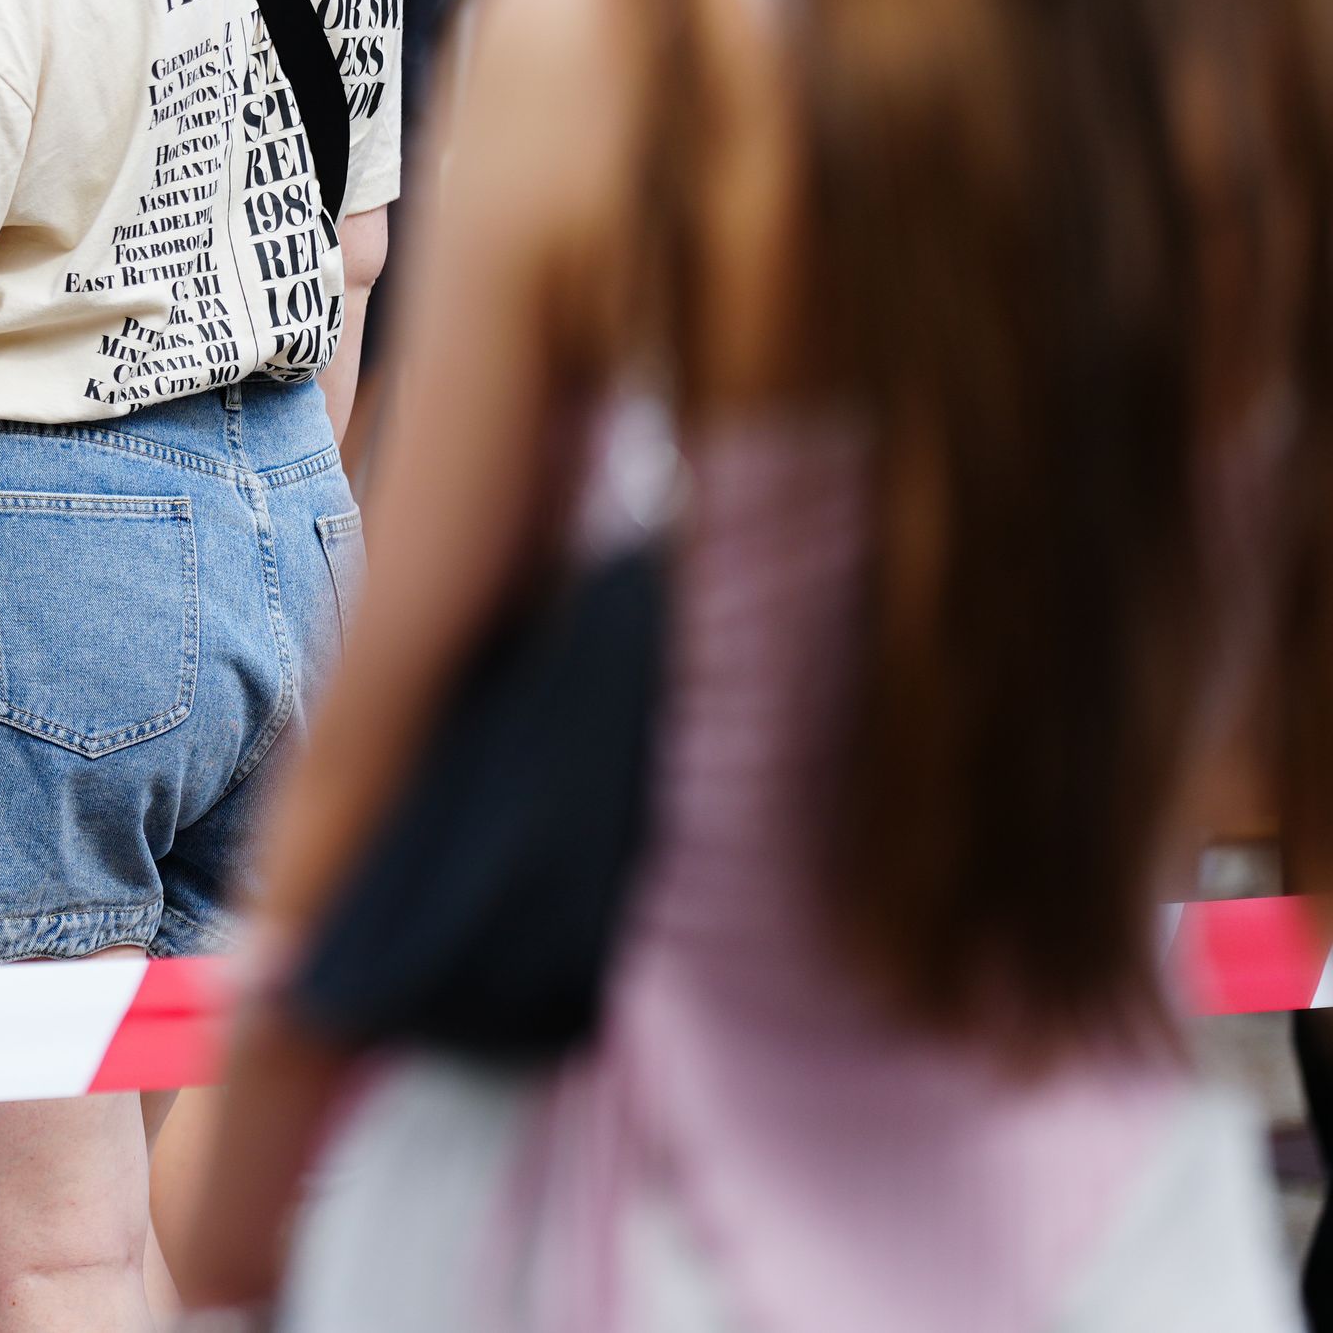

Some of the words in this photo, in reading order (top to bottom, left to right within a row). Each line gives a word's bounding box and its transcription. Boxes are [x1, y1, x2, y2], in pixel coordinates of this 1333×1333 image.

[151, 38, 220, 80] GLENDALE,
[148, 82, 174, 107] LAS
[64, 272, 115, 293] EAST
[192, 274, 222, 298] MI
[197, 297, 229, 320] PA
[196, 318, 235, 343] MN
[205, 341, 240, 365] OH
[205, 364, 241, 386] MO
